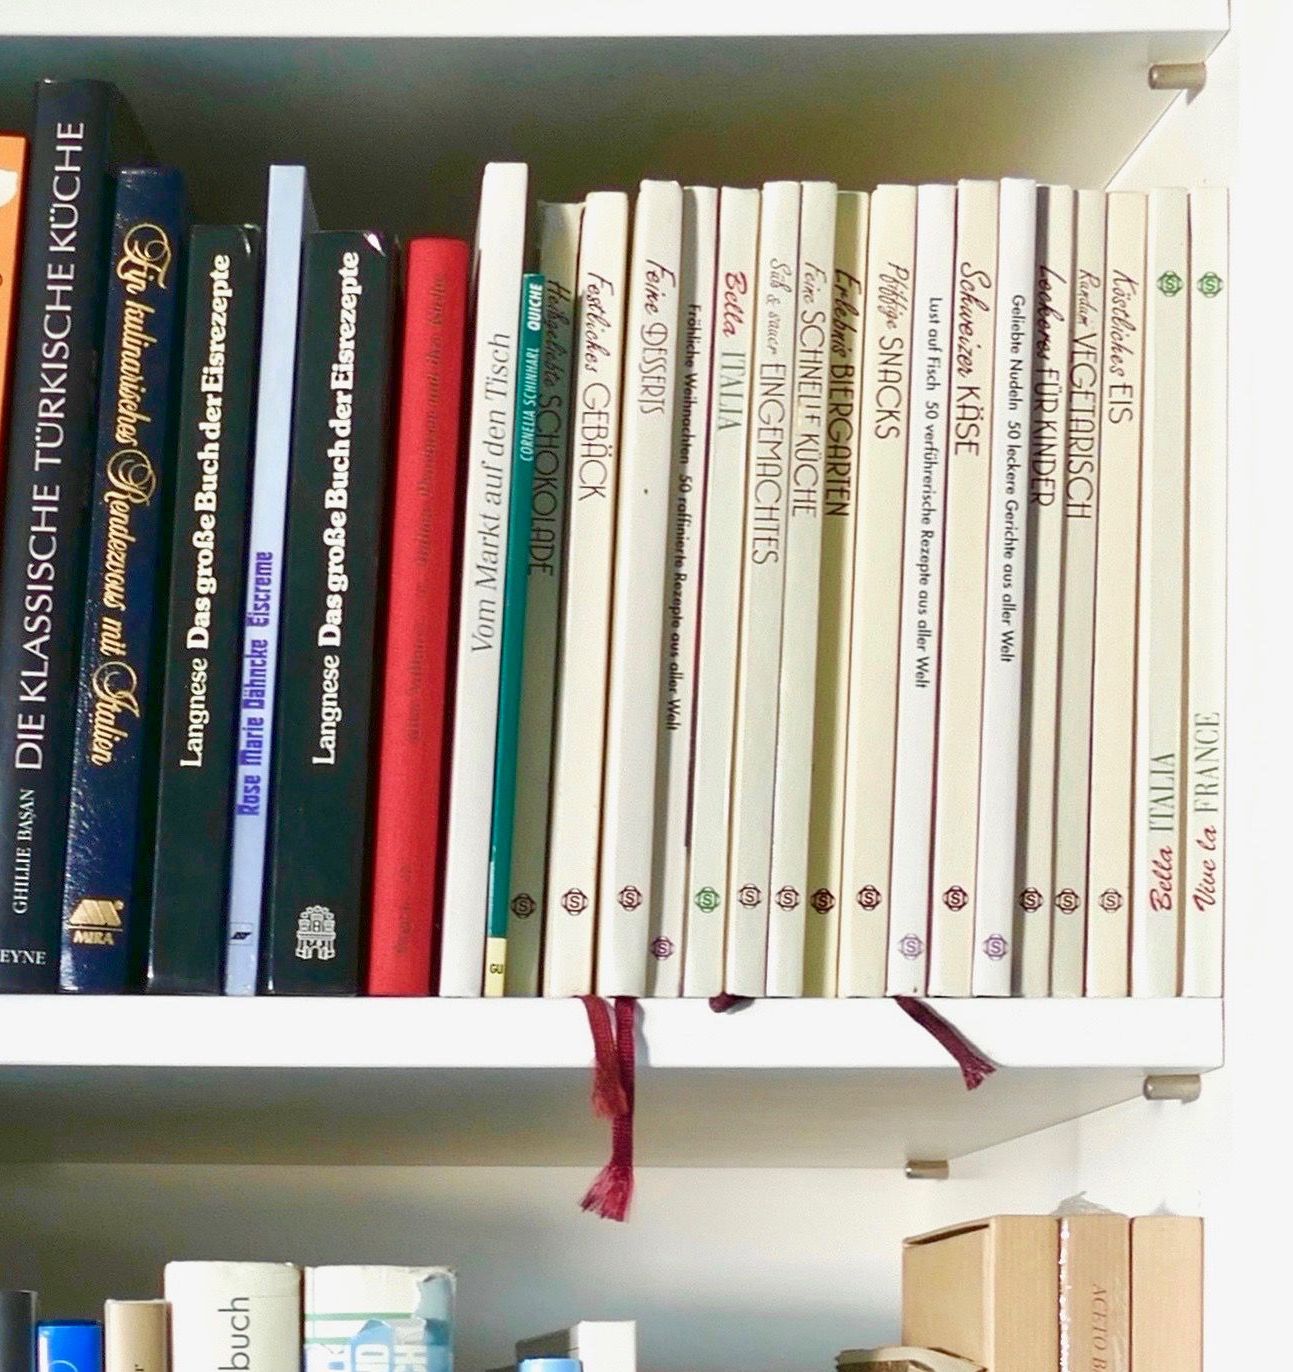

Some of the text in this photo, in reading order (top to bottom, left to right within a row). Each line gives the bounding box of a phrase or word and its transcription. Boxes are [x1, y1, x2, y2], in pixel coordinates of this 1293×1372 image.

[49, 123, 83, 251] KÜCHE
[35, 264, 74, 471] TÜRKISCHE
[519, 284, 543, 462] CORNELIA SCHINHARL QUICHE
[579, 273, 613, 501] Festliches GEBÄCK
[955, 262, 991, 455] Schweizer KÄSE
[472, 334, 510, 651] Vom Markt auf den Tisch
[19, 485, 59, 701] KLASSISCHE
[238, 552, 274, 814] Rose Marie Dähncke Eiscreme
[15, 714, 44, 769] DIE
[1150, 754, 1174, 911] Bella ITALIA
[13, 848, 30, 913] GHILLIE
